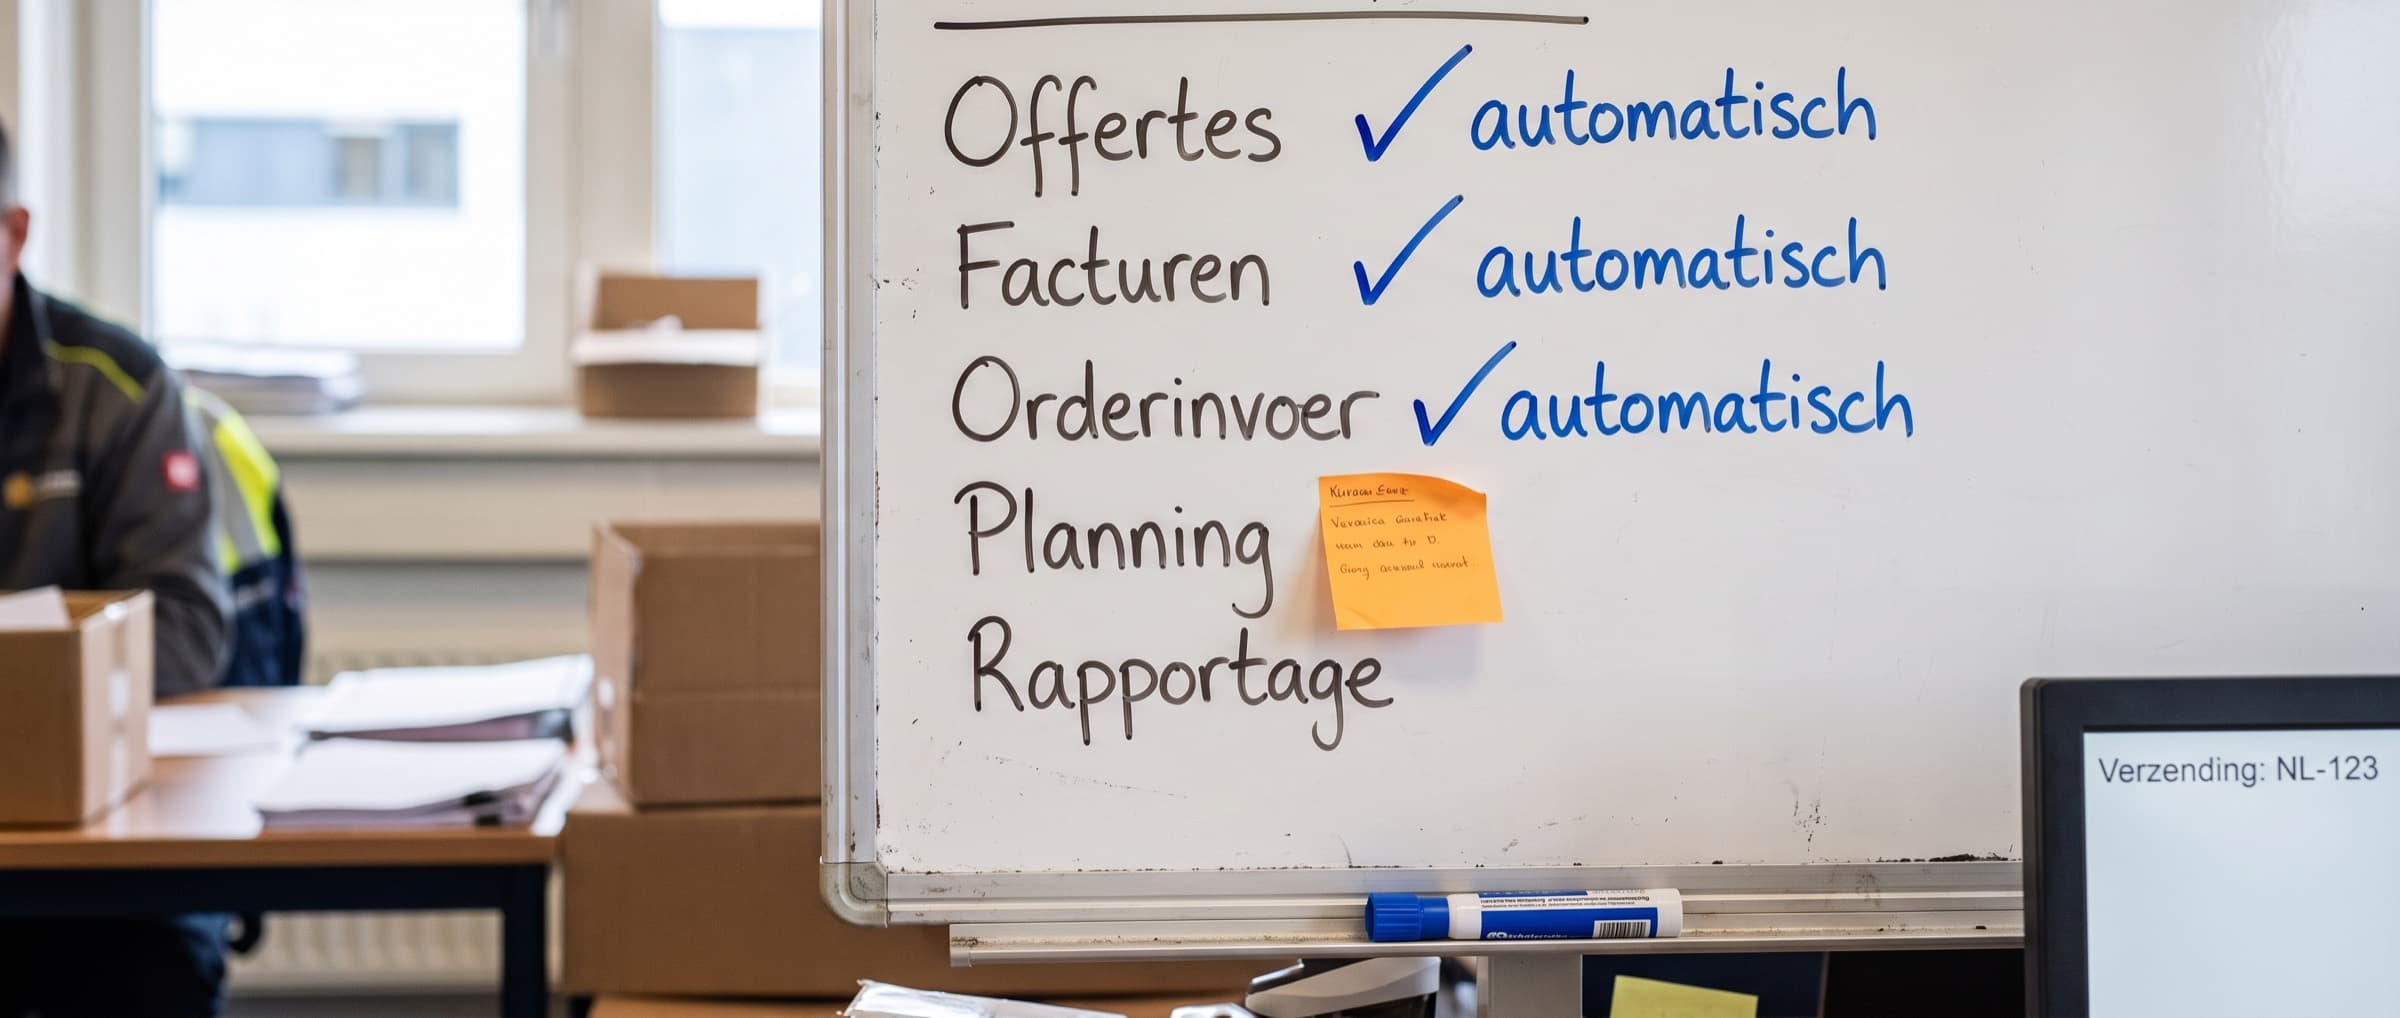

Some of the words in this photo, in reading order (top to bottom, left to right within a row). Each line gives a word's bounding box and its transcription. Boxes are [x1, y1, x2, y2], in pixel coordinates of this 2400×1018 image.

[944, 74, 1282, 198] Offertes
[1470, 66, 1876, 151] automatisch
[957, 220, 1270, 310] Facturen
[1476, 214, 1887, 298] automatisch
[952, 355, 1381, 443] Orderinvoer
[1500, 359, 1914, 442] automatisch
[954, 480, 1274, 618] Planning
[967, 614, 1394, 752] Rapportage
[2098, 756, 2266, 788] Verzending:
[2277, 755, 2380, 781] NL-123
